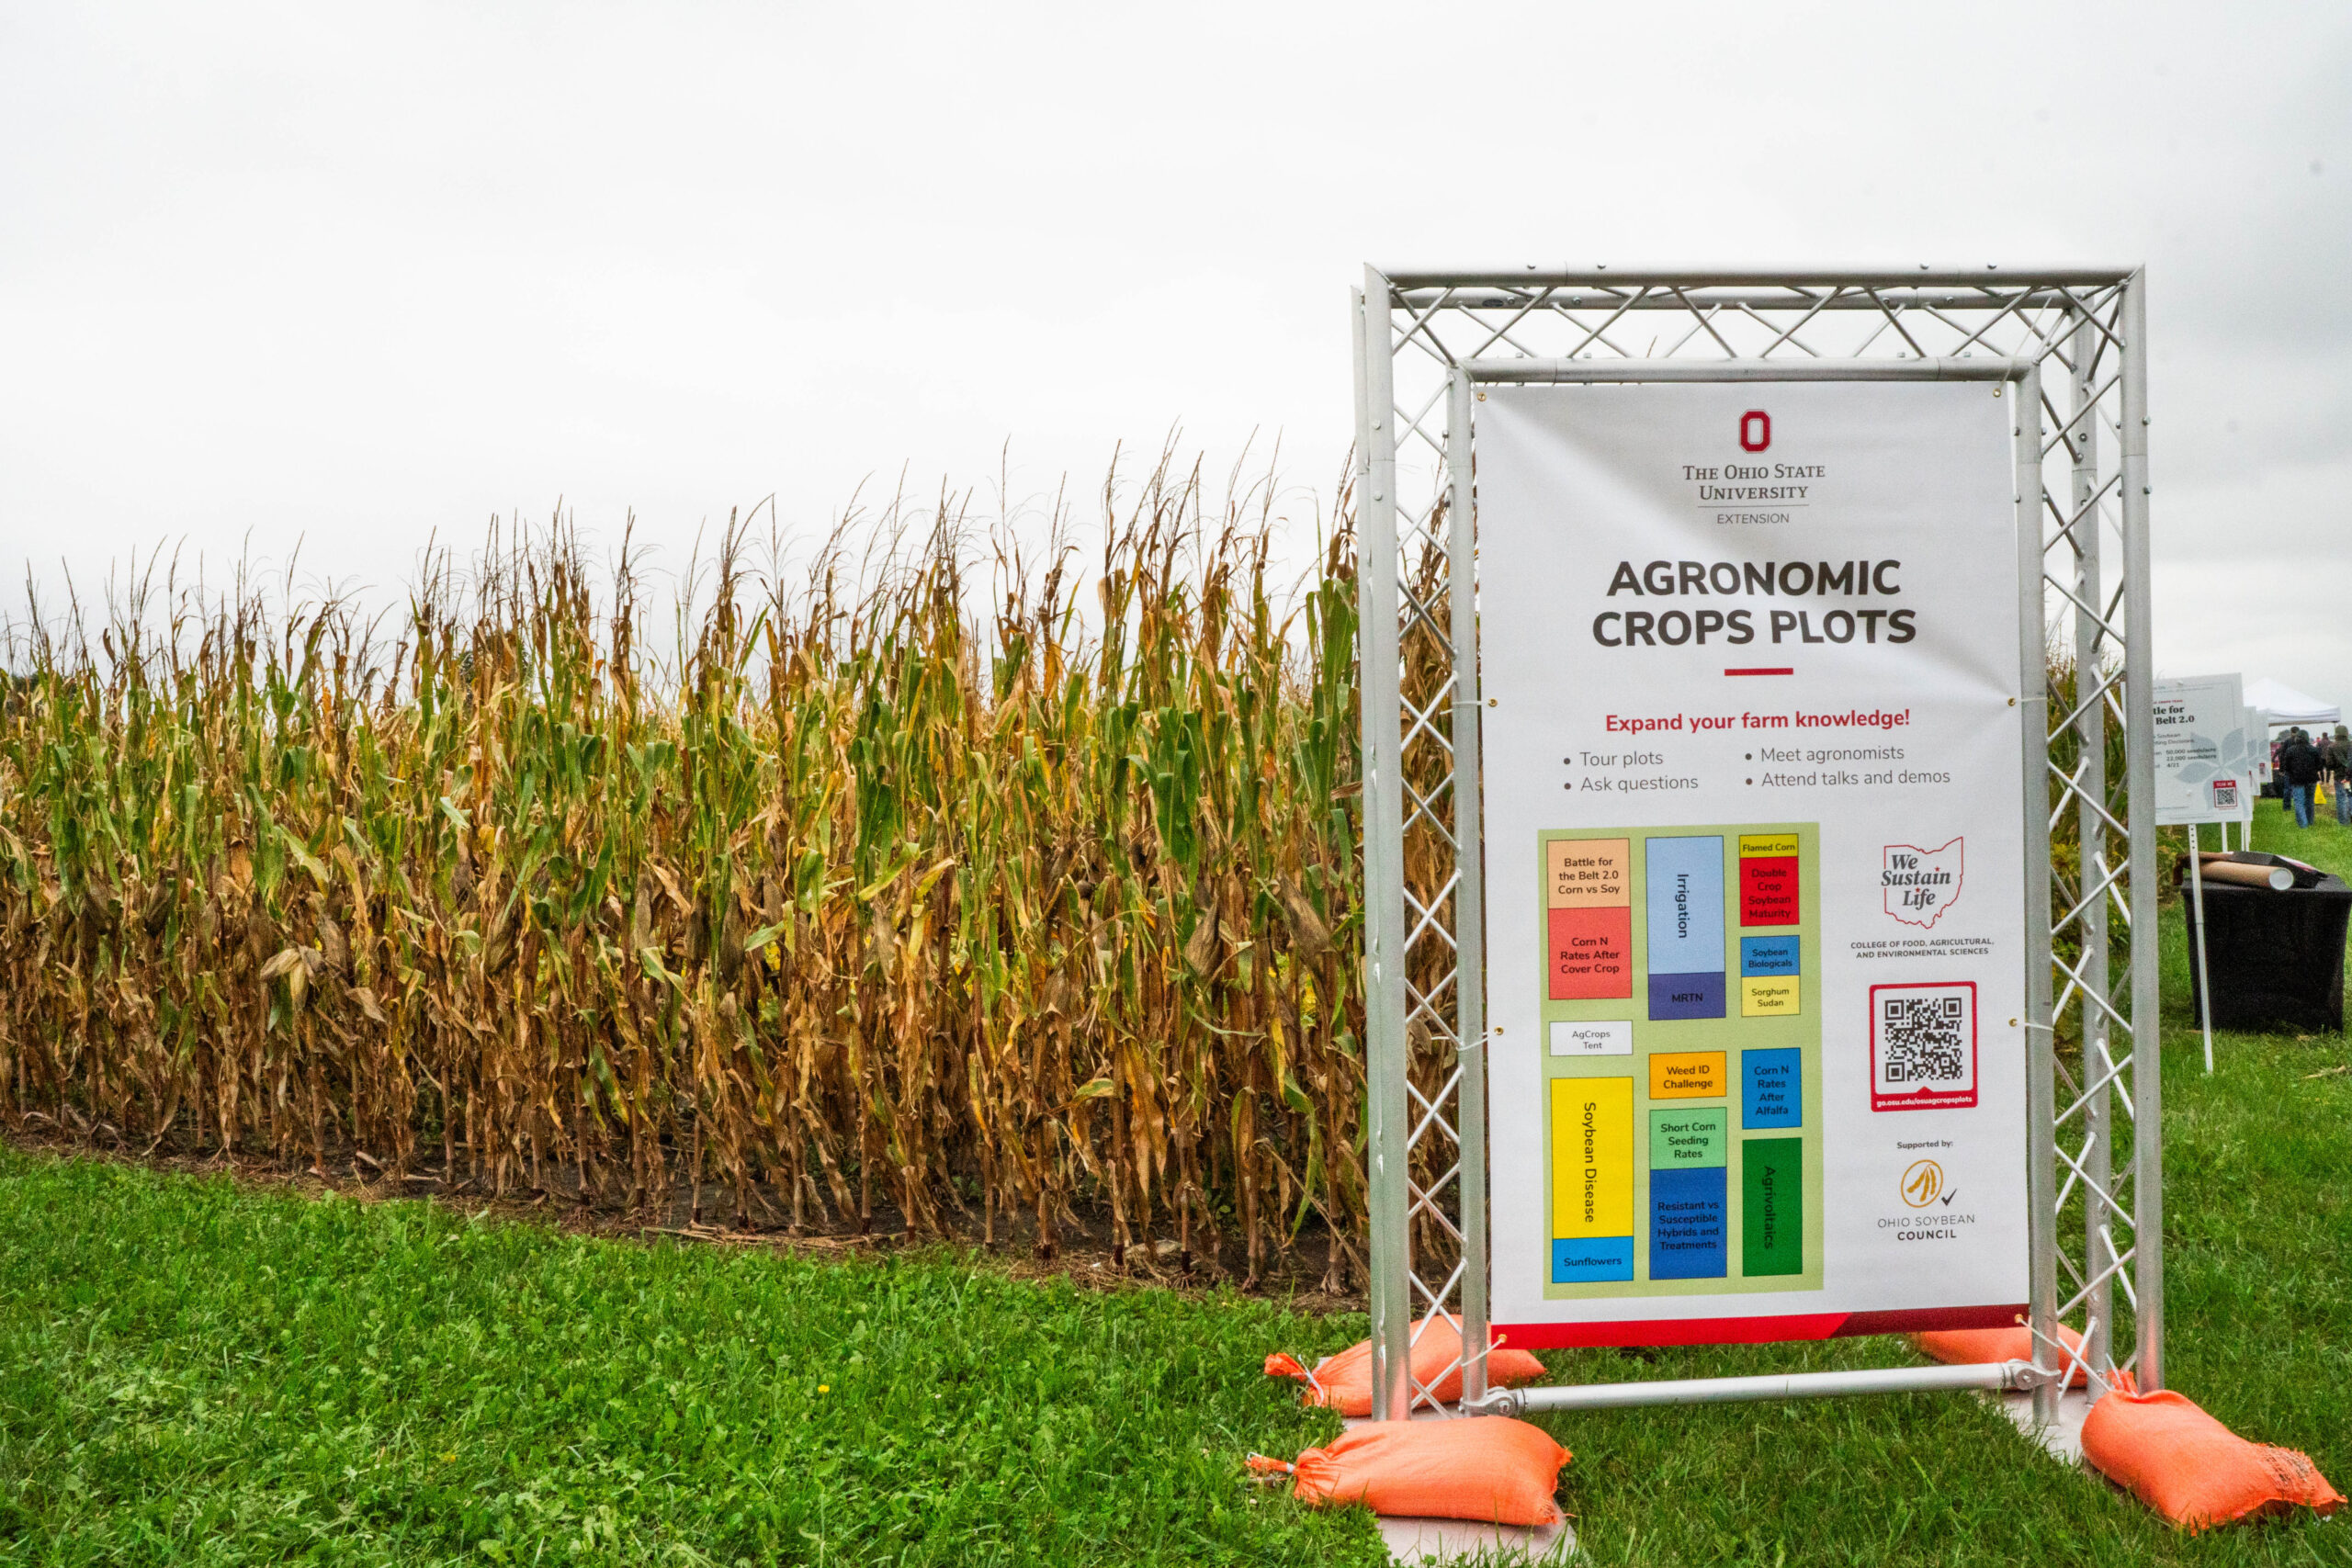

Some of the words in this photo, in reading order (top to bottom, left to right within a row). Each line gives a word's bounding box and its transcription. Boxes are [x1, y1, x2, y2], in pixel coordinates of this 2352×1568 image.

[1716, 513, 1790, 525] EXTENSION
[1606, 559, 1901, 597] AGRONOMIC
[1592, 610, 1755, 647] CROPS
[1770, 609, 1917, 645] PLOTS
[2153, 706, 2166, 715] tle
[2168, 705, 2185, 714] for
[1605, 714, 1682, 735] Expand
[1690, 715, 1736, 734] your
[1741, 711, 1789, 729] farm
[1795, 709, 1910, 734] knowledge!
[2155, 716, 2177, 725] Belt
[2178, 715, 2195, 724] 2.0
[1580, 751, 1617, 767] Tour
[1623, 750, 1664, 770] plots
[1760, 747, 1801, 763] Meet
[1806, 745, 1905, 766] agronomists
[1761, 771, 1817, 787] Attend
[1821, 769, 1859, 785] talks
[1863, 769, 1893, 784] and
[1898, 768, 1951, 784] demos
[1580, 775, 1611, 791] Ask
[1616, 774, 1698, 794] questions
[1742, 843, 1772, 852] Flamed
[1775, 843, 1796, 852] Corn
[1564, 857, 1595, 867] Battle
[1598, 857, 1613, 866] for
[1891, 854, 1918, 870] We
[1559, 871, 1576, 880] the
[1578, 871, 1600, 880] Belt
[1603, 870, 1619, 879] 2.0
[1751, 868, 1787, 878] Double
[1881, 869, 1951, 886] Sustain
[1558, 885, 1583, 895] Corn
[1600, 884, 1620, 896] Soy
[1758, 882, 1782, 894] Crop
[1748, 895, 1791, 908] Soybean
[1902, 887, 1936, 910] Life
[1675, 874, 1690, 939] Irrigation
[1749, 908, 1792, 920] Maturity
[1571, 937, 1597, 946] Corn
[1600, 937, 1608, 945] N
[1850, 941, 1887, 949] COLLEGE
[1902, 940, 1928, 948] FOOD,
[1929, 938, 1995, 946] AGRICULTURAL,
[1561, 951, 1590, 961] Rates
[1593, 950, 1620, 960] After
[1752, 948, 1789, 959] Soybean
[1856, 950, 1874, 959] AND
[1877, 949, 1947, 958] ENVIRONMENTAL
[1950, 947, 1989, 955] SCIENCES
[1561, 964, 1591, 974] Cover
[1594, 964, 1620, 975] Crop
[1748, 959, 1792, 970] Biologicals
[1671, 993, 1704, 1003] MRTN
[1751, 987, 1790, 998] Sorghum
[1758, 998, 1784, 1008] Sudan
[1572, 1030, 1611, 1040] AgCrops
[1583, 1041, 1602, 1050] Tent
[1667, 1066, 1696, 1076] Weed
[1699, 1065, 1710, 1075] ID
[1754, 1066, 1778, 1076] Corn
[1781, 1066, 1789, 1075] N
[1663, 1078, 1713, 1090] Challenge
[1758, 1079, 1786, 1089] Rates
[1759, 1092, 1784, 1102] After
[1755, 1105, 1789, 1116] Alfalfa
[1582, 1102, 1597, 1164] Soybean
[1660, 1122, 1690, 1133] Short
[1691, 1122, 1716, 1132] Corn
[1668, 1135, 1709, 1147] Seeding
[1896, 1140, 1939, 1150] Supported
[1941, 1140, 1953, 1148] by:
[1674, 1149, 1702, 1158] Rates
[1585, 1168, 1597, 1223] Disease
[1657, 1201, 1705, 1212] Resistant
[1708, 1201, 1719, 1210] vs
[1761, 1166, 1776, 1249] Agrivoltaics
[1658, 1214, 1718, 1227] Susceptible
[1877, 1217, 1910, 1228] OHIO
[1915, 1213, 1975, 1227] SOYBEAN
[1657, 1227, 1698, 1240] Hybrids
[1700, 1226, 1719, 1236] and
[1897, 1229, 1957, 1241] COUNCIL
[1659, 1240, 1717, 1250] Treatments
[1564, 1257, 1623, 1267] Sunflowers
